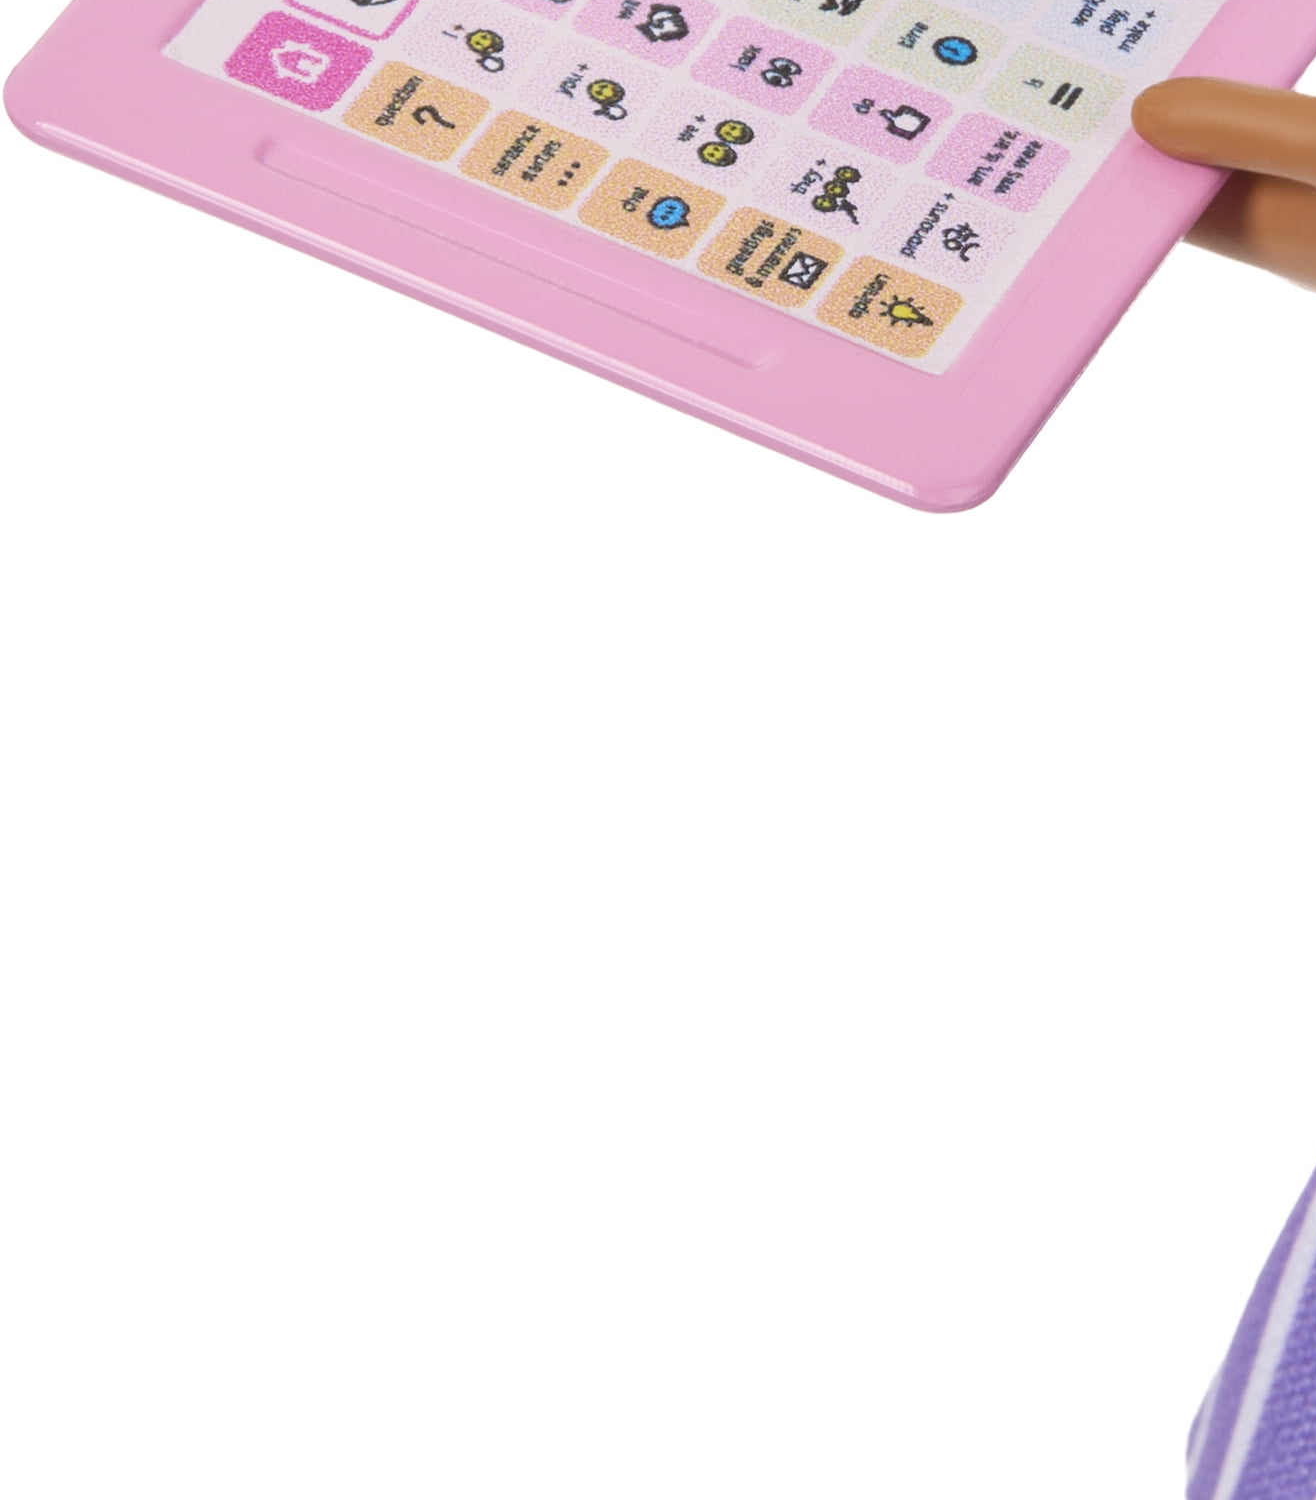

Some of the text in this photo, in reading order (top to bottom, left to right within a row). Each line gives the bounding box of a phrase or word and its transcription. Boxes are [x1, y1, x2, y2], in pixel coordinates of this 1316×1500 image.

[897, 21, 929, 50] time
[1099, 9, 1130, 36] play,
[1118, 20, 1151, 51] make
[730, 45, 762, 72] look
[556, 73, 584, 99] you
[374, 75, 423, 127] question
[852, 97, 876, 116] do
[677, 124, 699, 142] we
[491, 125, 541, 177] sentence
[521, 140, 562, 182] starters
[1013, 140, 1043, 169] were
[790, 168, 824, 195] they
[621, 186, 650, 213] chat
[900, 201, 949, 260] pronouns
[725, 219, 775, 277] greetings
[744, 227, 802, 288] & manners
[848, 273, 890, 319] opinion
